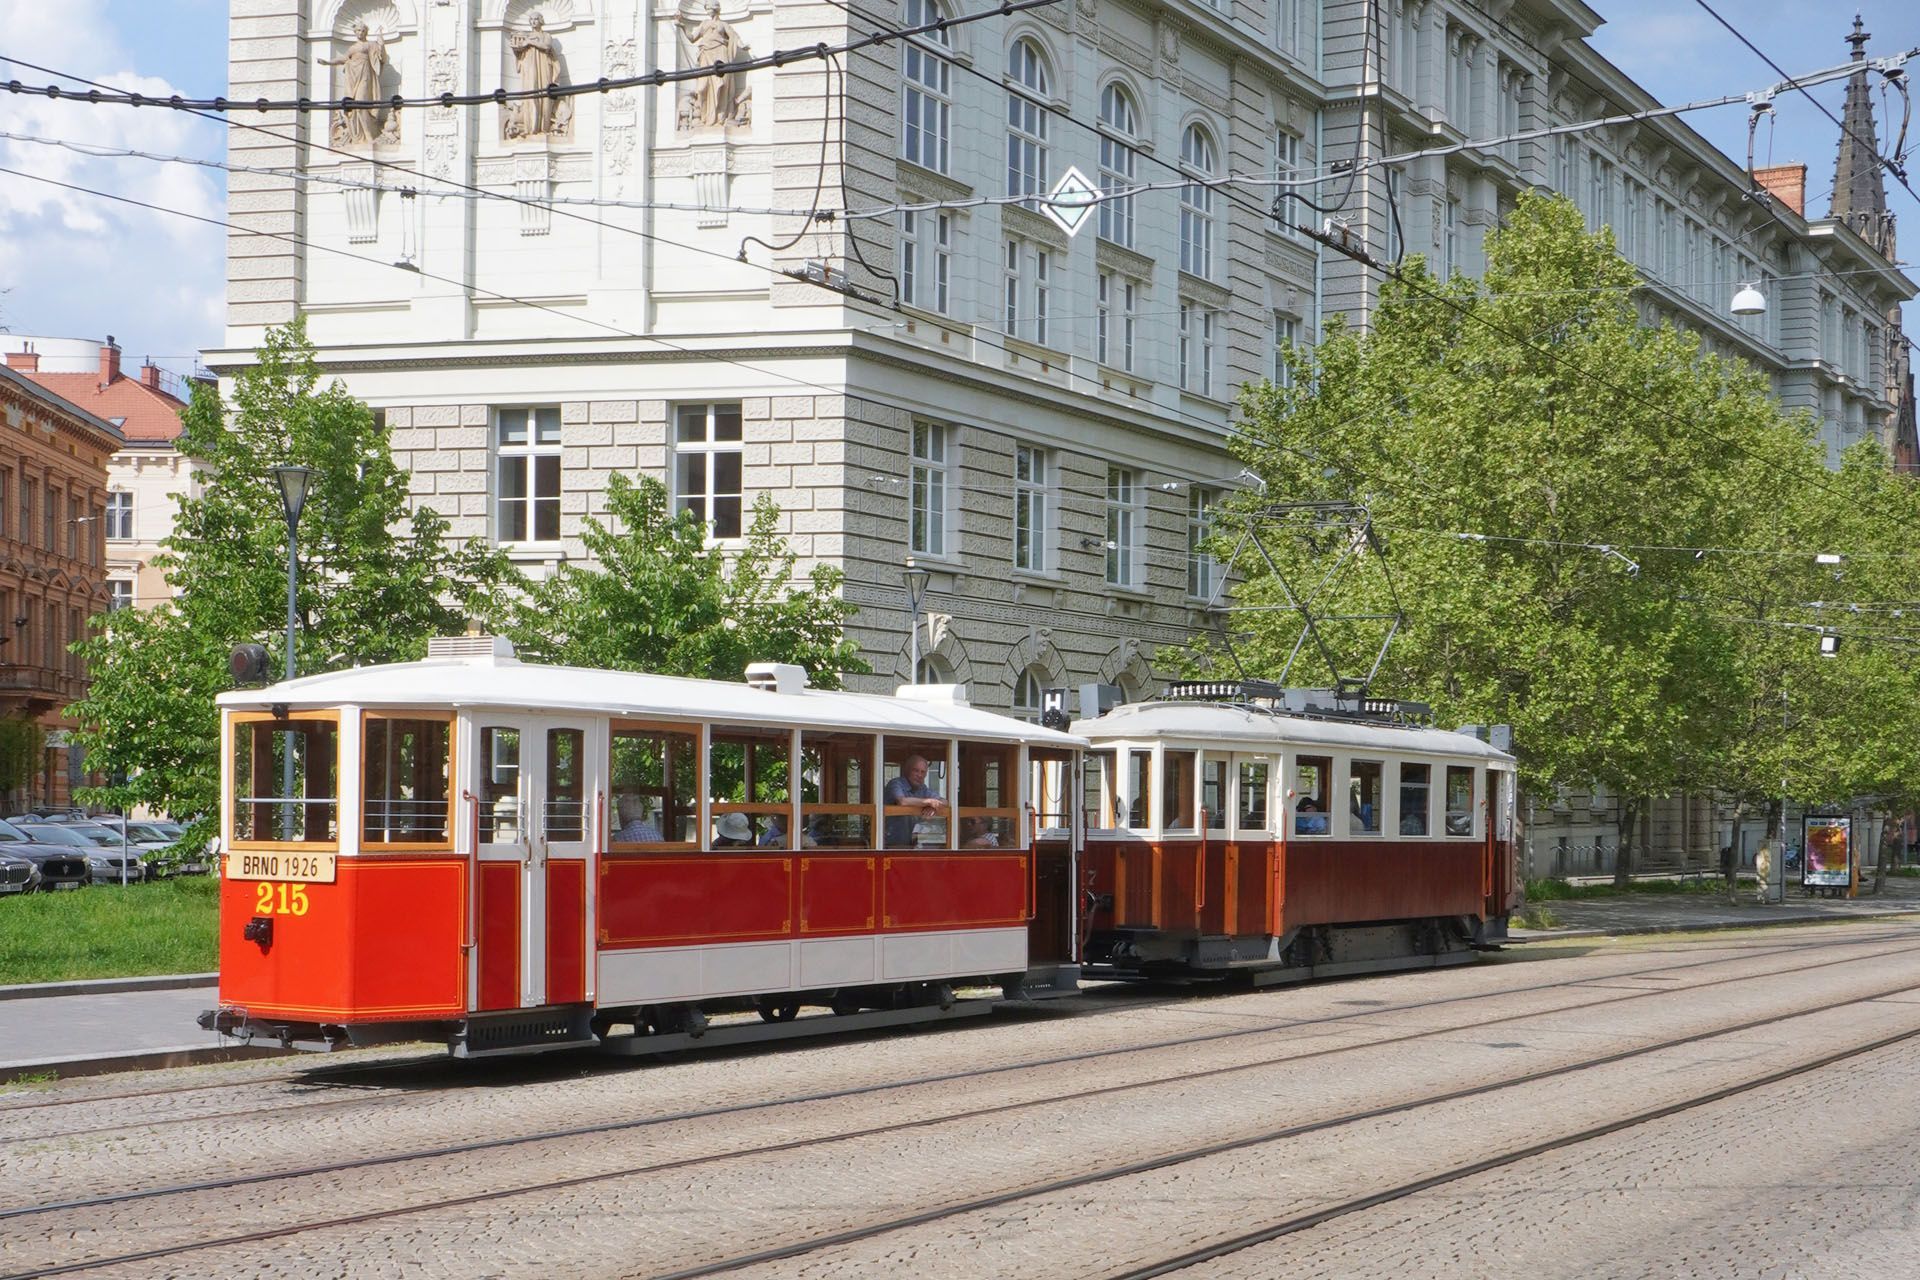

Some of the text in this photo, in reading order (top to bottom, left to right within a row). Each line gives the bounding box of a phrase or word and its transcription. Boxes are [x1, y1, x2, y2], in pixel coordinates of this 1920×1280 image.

[243, 855, 318, 877] BRNO 1926
[255, 881, 309, 916] 215
